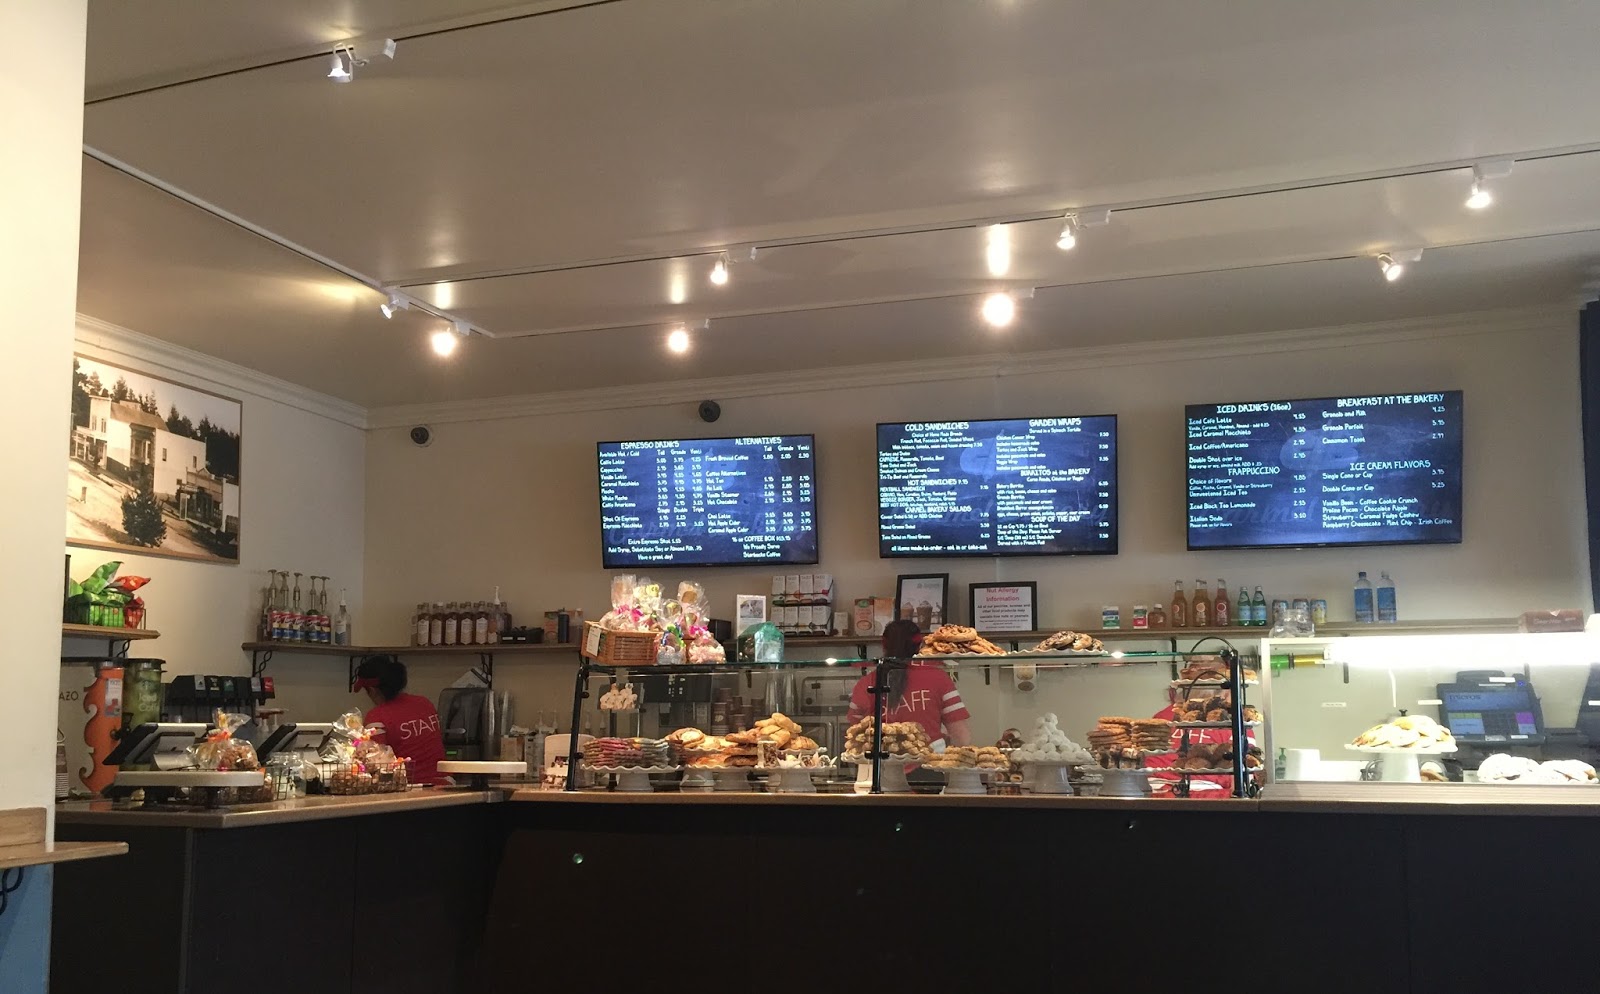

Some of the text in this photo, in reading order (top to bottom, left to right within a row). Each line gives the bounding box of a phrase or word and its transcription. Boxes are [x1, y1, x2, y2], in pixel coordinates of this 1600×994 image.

[1337, 394, 1444, 407] BREAKFAST AT THE BAKERY
[1217, 405, 1237, 413] ICED
[1238, 403, 1269, 412] DRINKS
[925, 422, 969, 431] SANDWICHES
[1029, 419, 1056, 427] GARDEN
[735, 437, 782, 445] ALTERNATIVES
[1350, 460, 1431, 471] ICE CREAM FLAVORS
[1228, 467, 1280, 476] FRAPPUCCINO
[59, 691, 79, 701] AZO
[881, 689, 931, 717] SAFF
